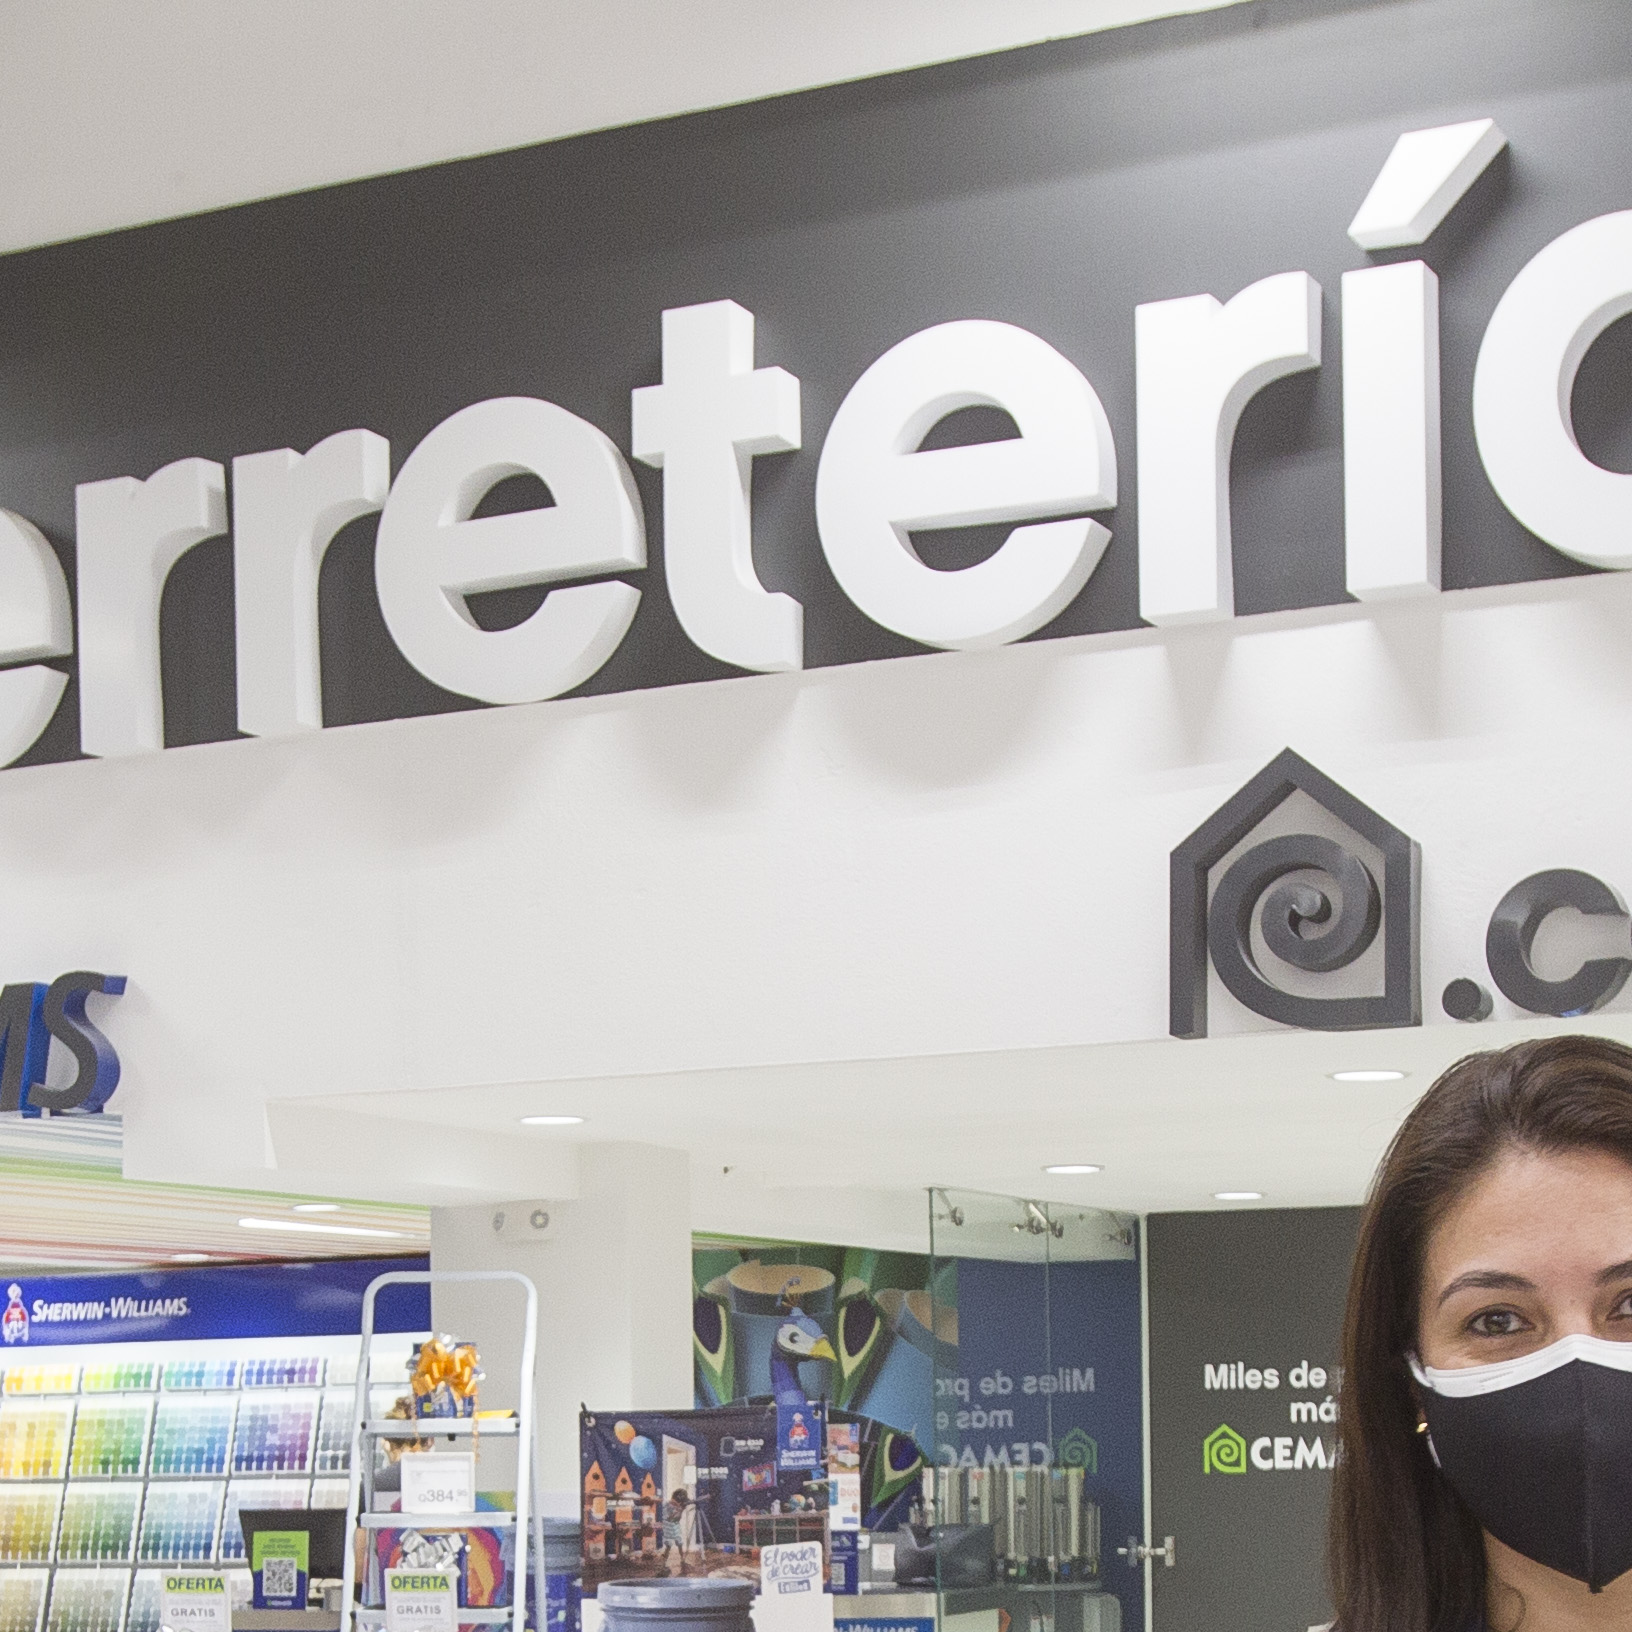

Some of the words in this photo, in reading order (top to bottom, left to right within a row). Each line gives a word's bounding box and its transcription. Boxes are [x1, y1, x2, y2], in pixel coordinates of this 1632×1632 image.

[31, 1297, 188, 1323] SHERWIN-WILLIAMS
[1204, 1363, 1279, 1391] Miles
[1289, 1360, 1326, 1388] de
[1290, 1396, 1338, 1423] má
[1251, 1437, 1338, 1469] CEM
[167, 1576, 224, 1592] OFERTA
[391, 1575, 449, 1591] OFERTA
[171, 1607, 216, 1618] GRATIS
[396, 1604, 441, 1615] GRATIS
